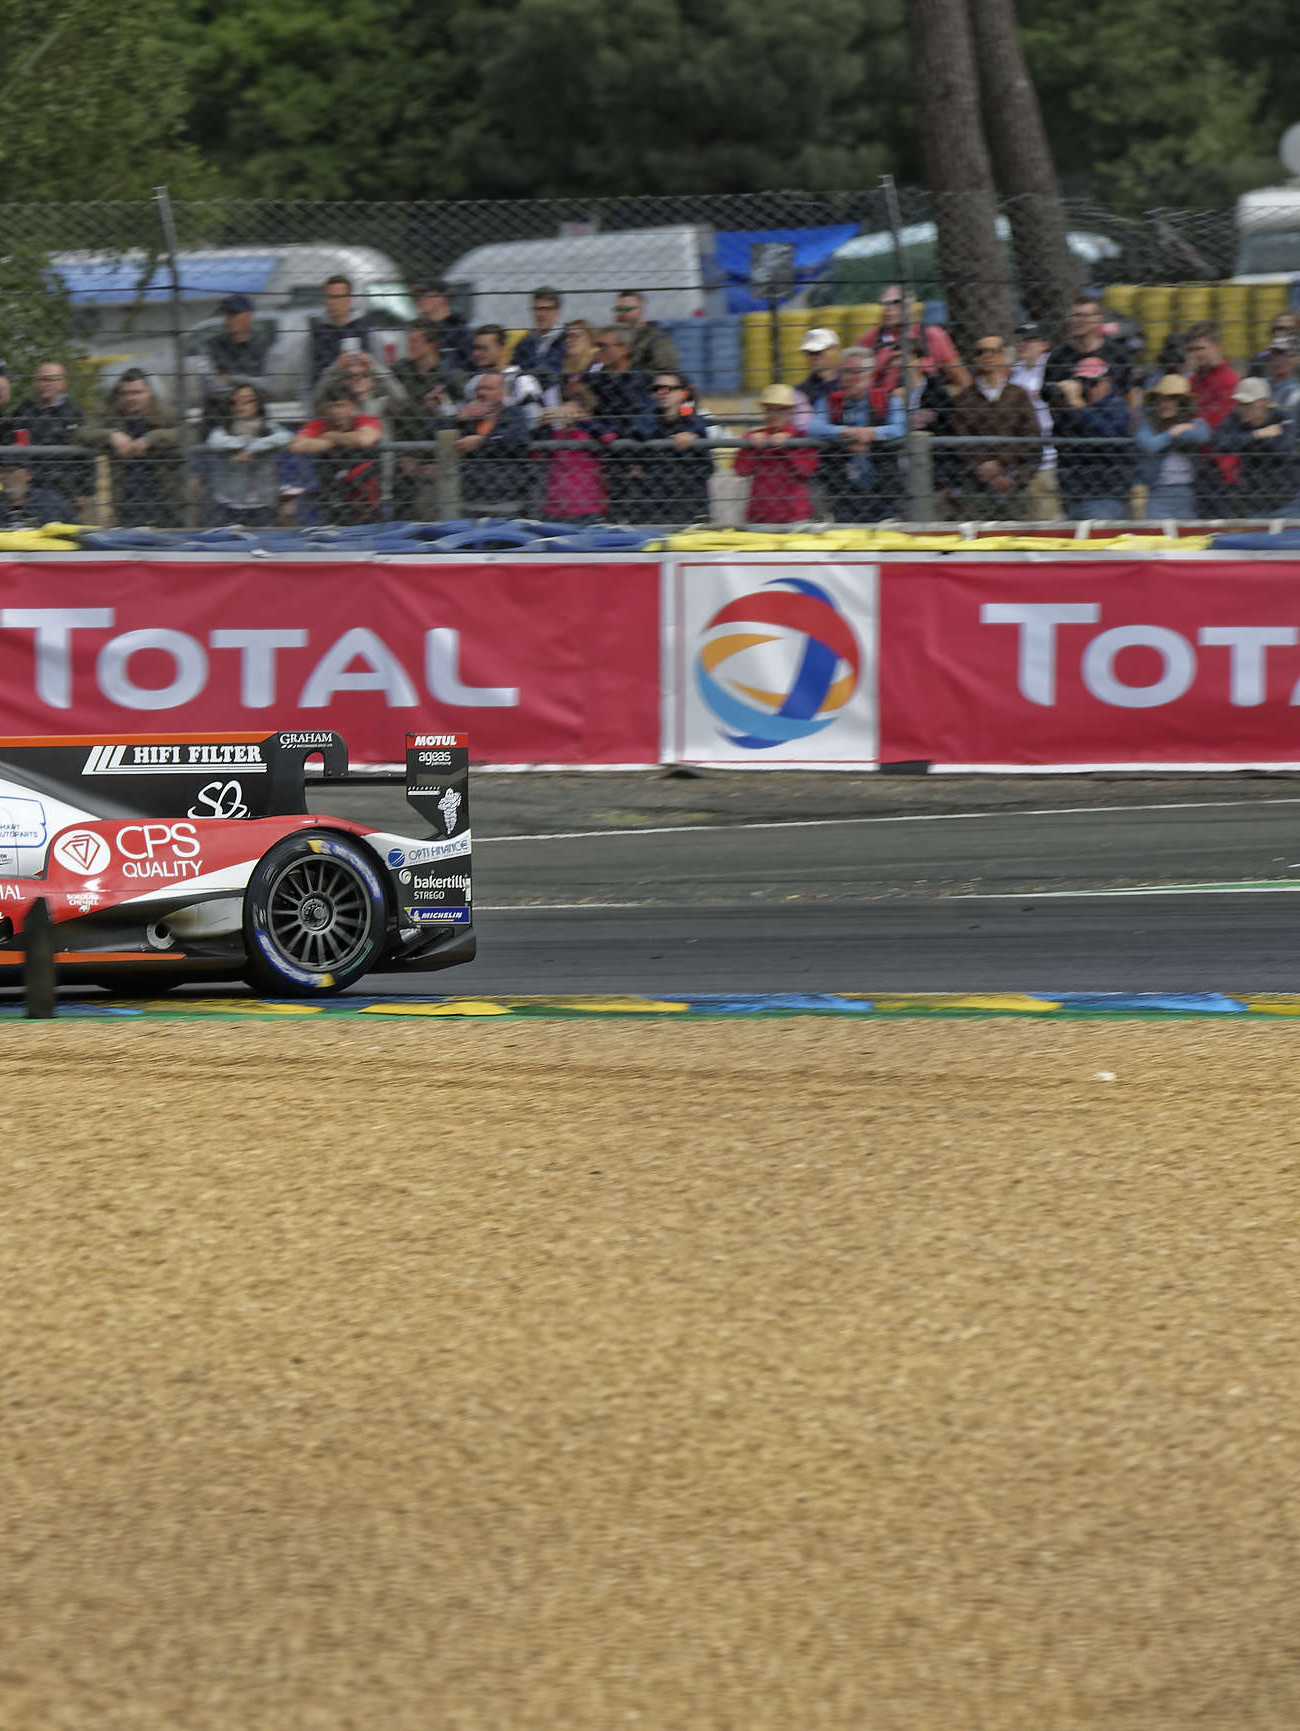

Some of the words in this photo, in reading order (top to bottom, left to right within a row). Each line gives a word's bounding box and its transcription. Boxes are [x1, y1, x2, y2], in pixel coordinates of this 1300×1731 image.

[980, 603, 1300, 708] TOT
[280, 733, 332, 744] GRAHAM
[415, 735, 457, 746] MOTUL
[133, 746, 180, 763] HIFI
[188, 746, 262, 763] FILTER
[418, 751, 451, 765] ageas
[116, 823, 200, 859] CPS
[122, 860, 203, 877] QUALITY
[413, 874, 468, 891] bakertilly
[413, 891, 445, 900] STREGO
[421, 911, 463, 919] MICHELIN
